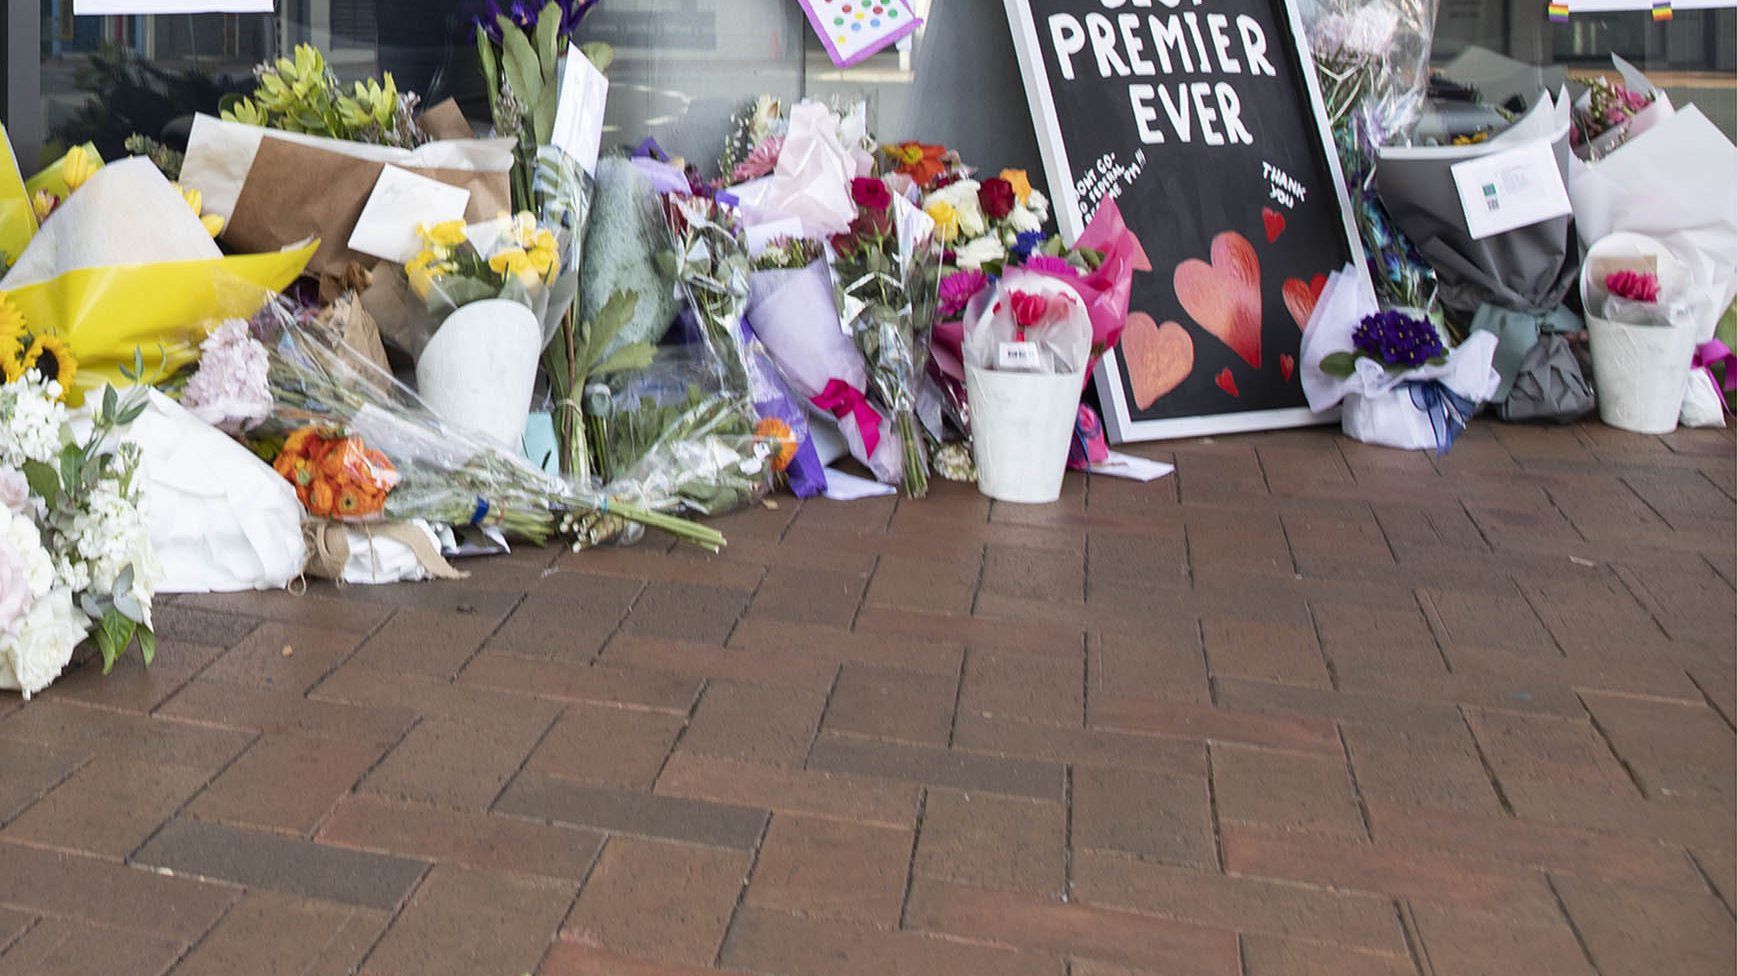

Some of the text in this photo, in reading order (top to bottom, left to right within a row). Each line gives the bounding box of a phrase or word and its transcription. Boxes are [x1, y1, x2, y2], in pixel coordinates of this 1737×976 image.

[1048, 13, 1277, 80] PREMIER
[1128, 82, 1255, 147] EVER
[1261, 160, 1307, 203] THANK
[1270, 185, 1294, 210] YOU
